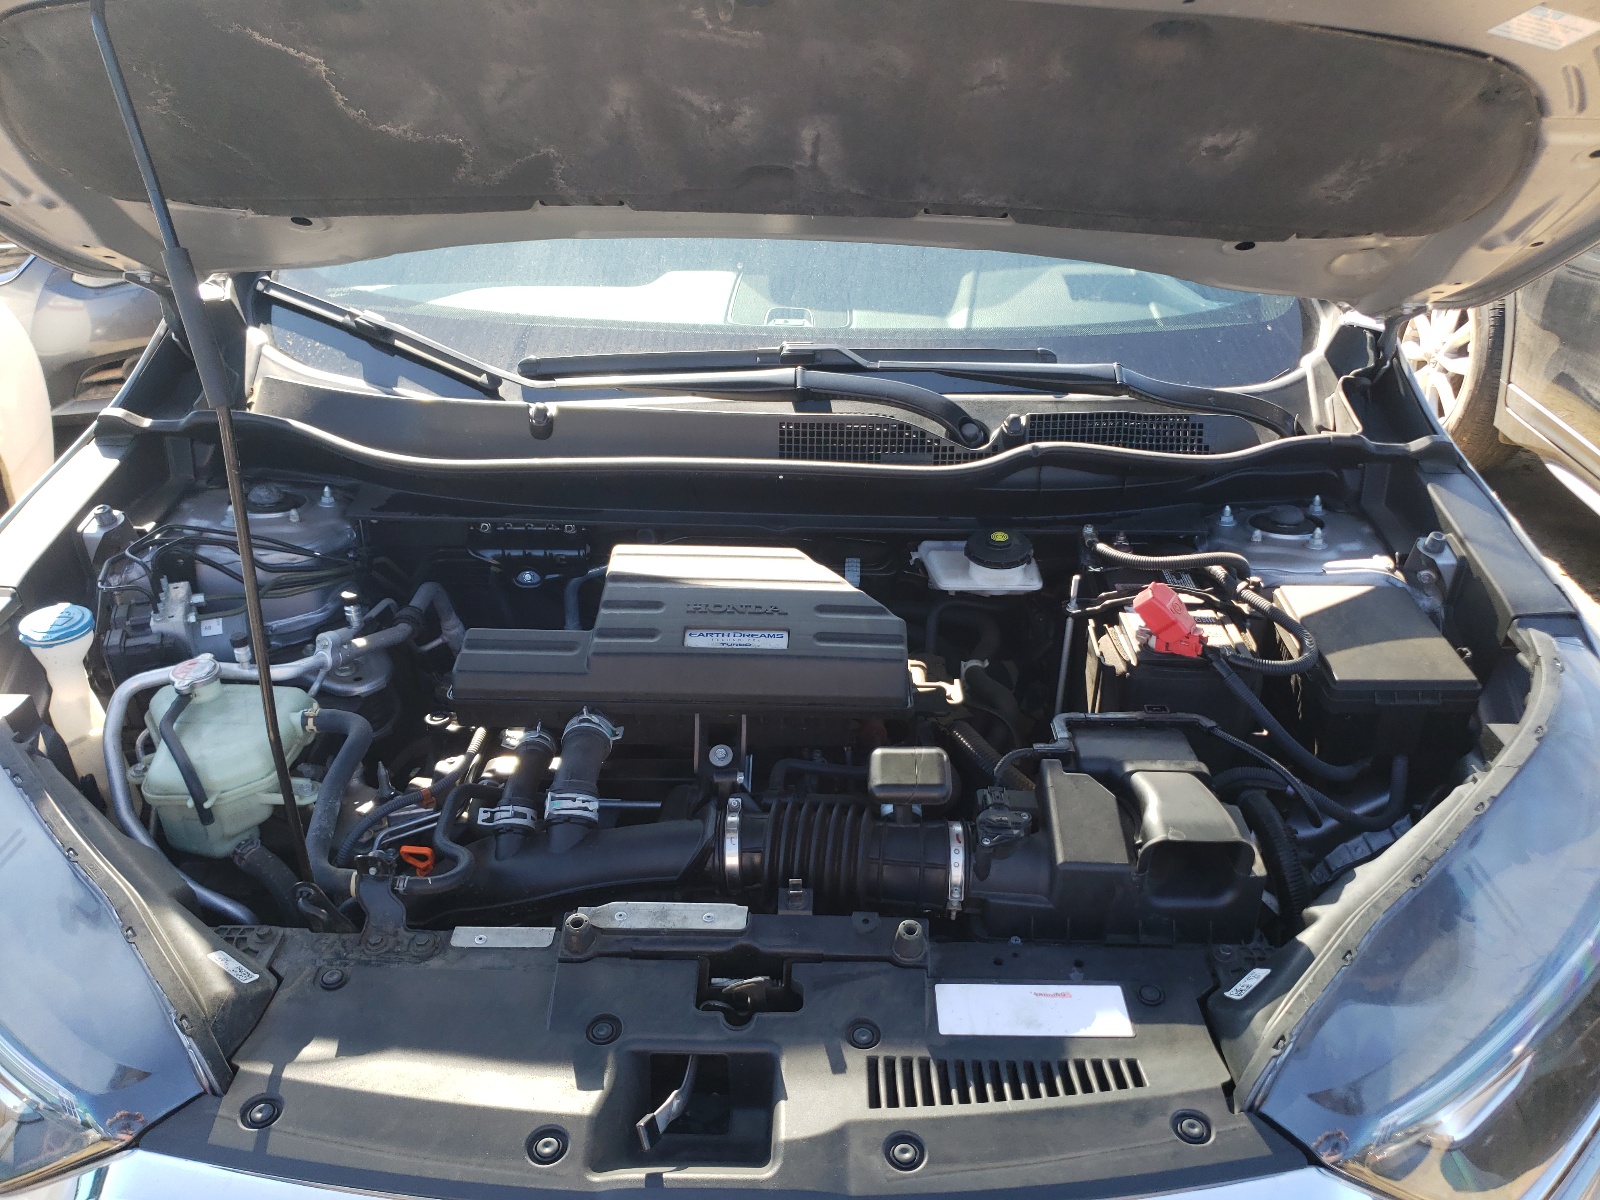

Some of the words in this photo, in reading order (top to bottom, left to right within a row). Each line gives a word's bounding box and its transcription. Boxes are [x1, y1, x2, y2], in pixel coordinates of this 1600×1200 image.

[686, 603, 788, 615] HONDA
[688, 631, 731, 639] EARTH
[733, 631, 784, 639] DREAMS
